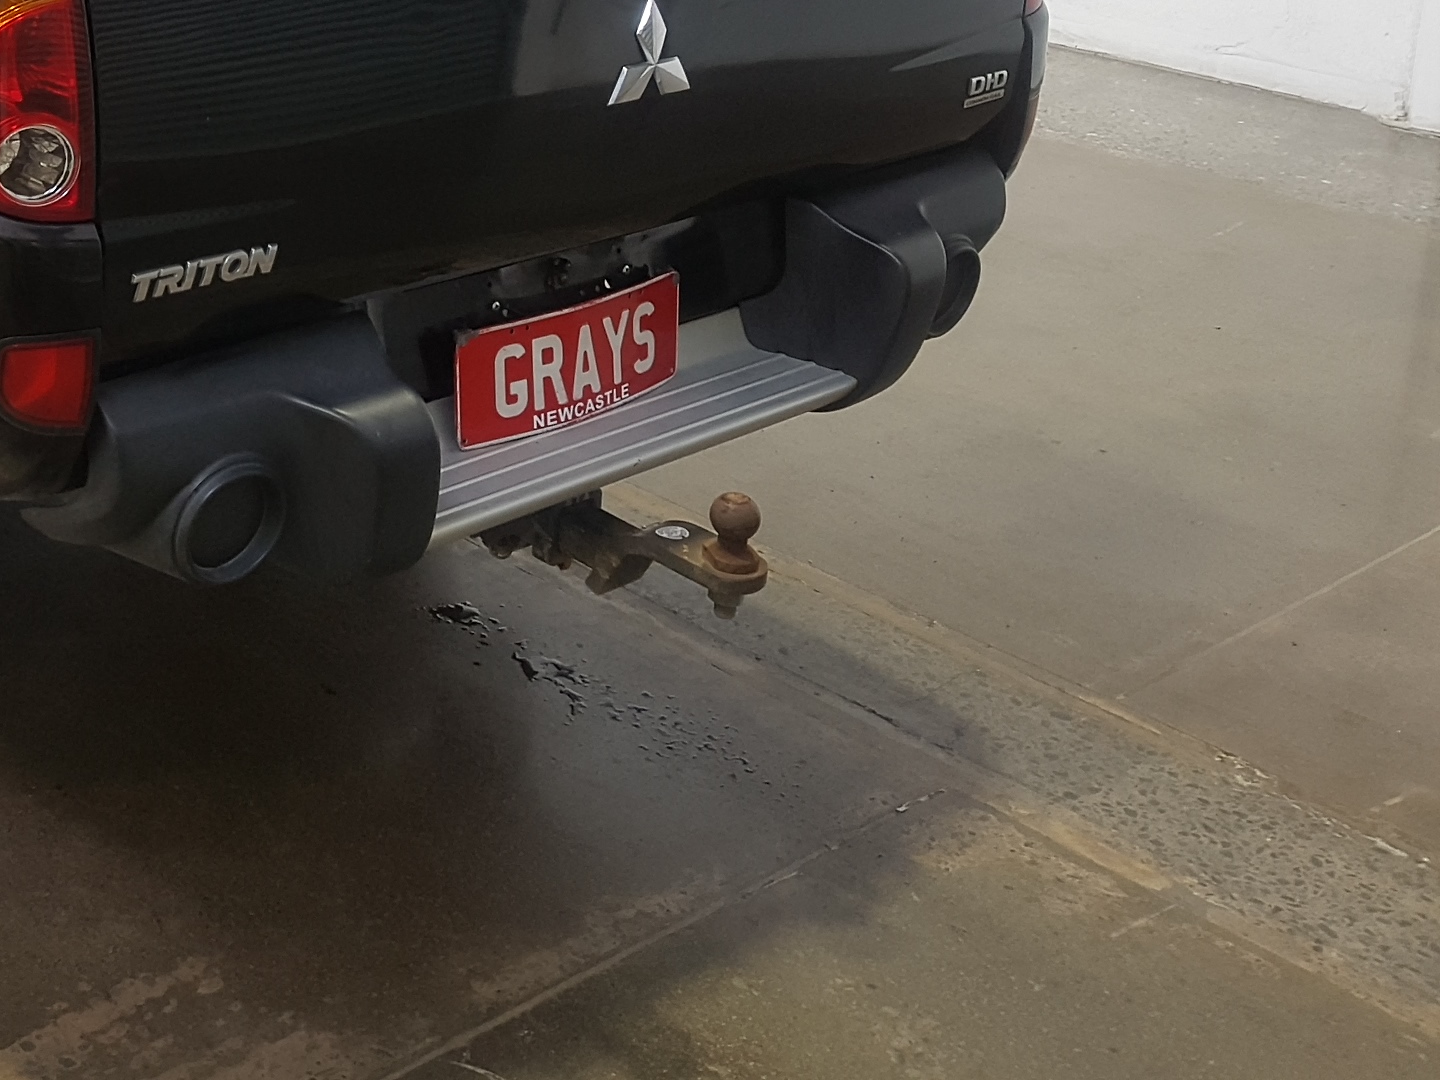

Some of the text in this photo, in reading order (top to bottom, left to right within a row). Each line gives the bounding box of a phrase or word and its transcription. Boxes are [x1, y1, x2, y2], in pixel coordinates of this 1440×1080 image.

[131, 243, 279, 303] TRITON
[494, 301, 656, 419] GRAYS
[533, 383, 630, 429] NEWCASTLE
